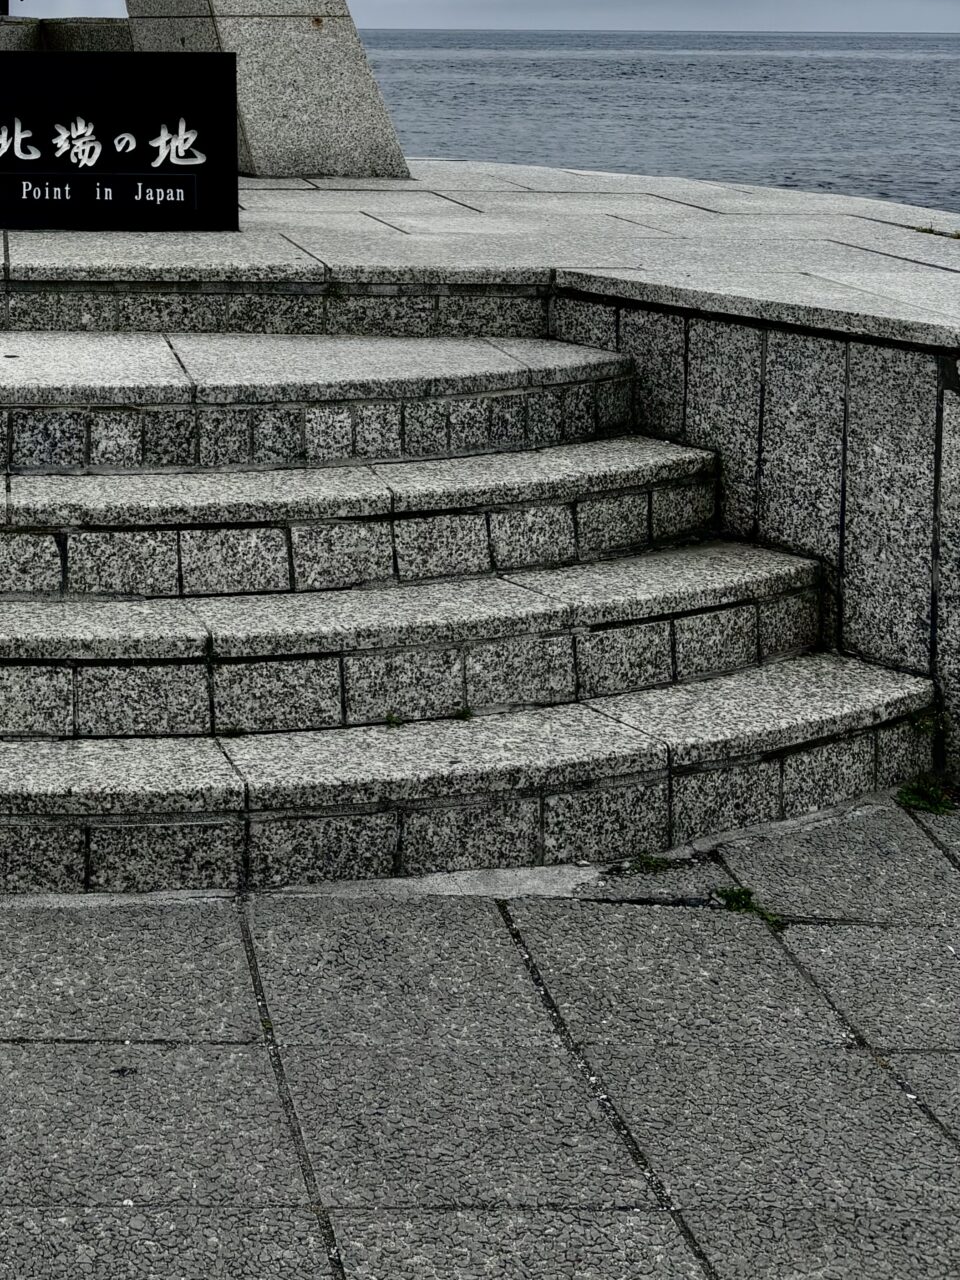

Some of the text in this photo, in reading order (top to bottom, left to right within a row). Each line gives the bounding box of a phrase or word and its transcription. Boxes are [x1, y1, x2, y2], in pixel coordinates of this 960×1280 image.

[21, 181, 71, 200] Point
[96, 182, 113, 200] in
[134, 182, 186, 205] Japan
